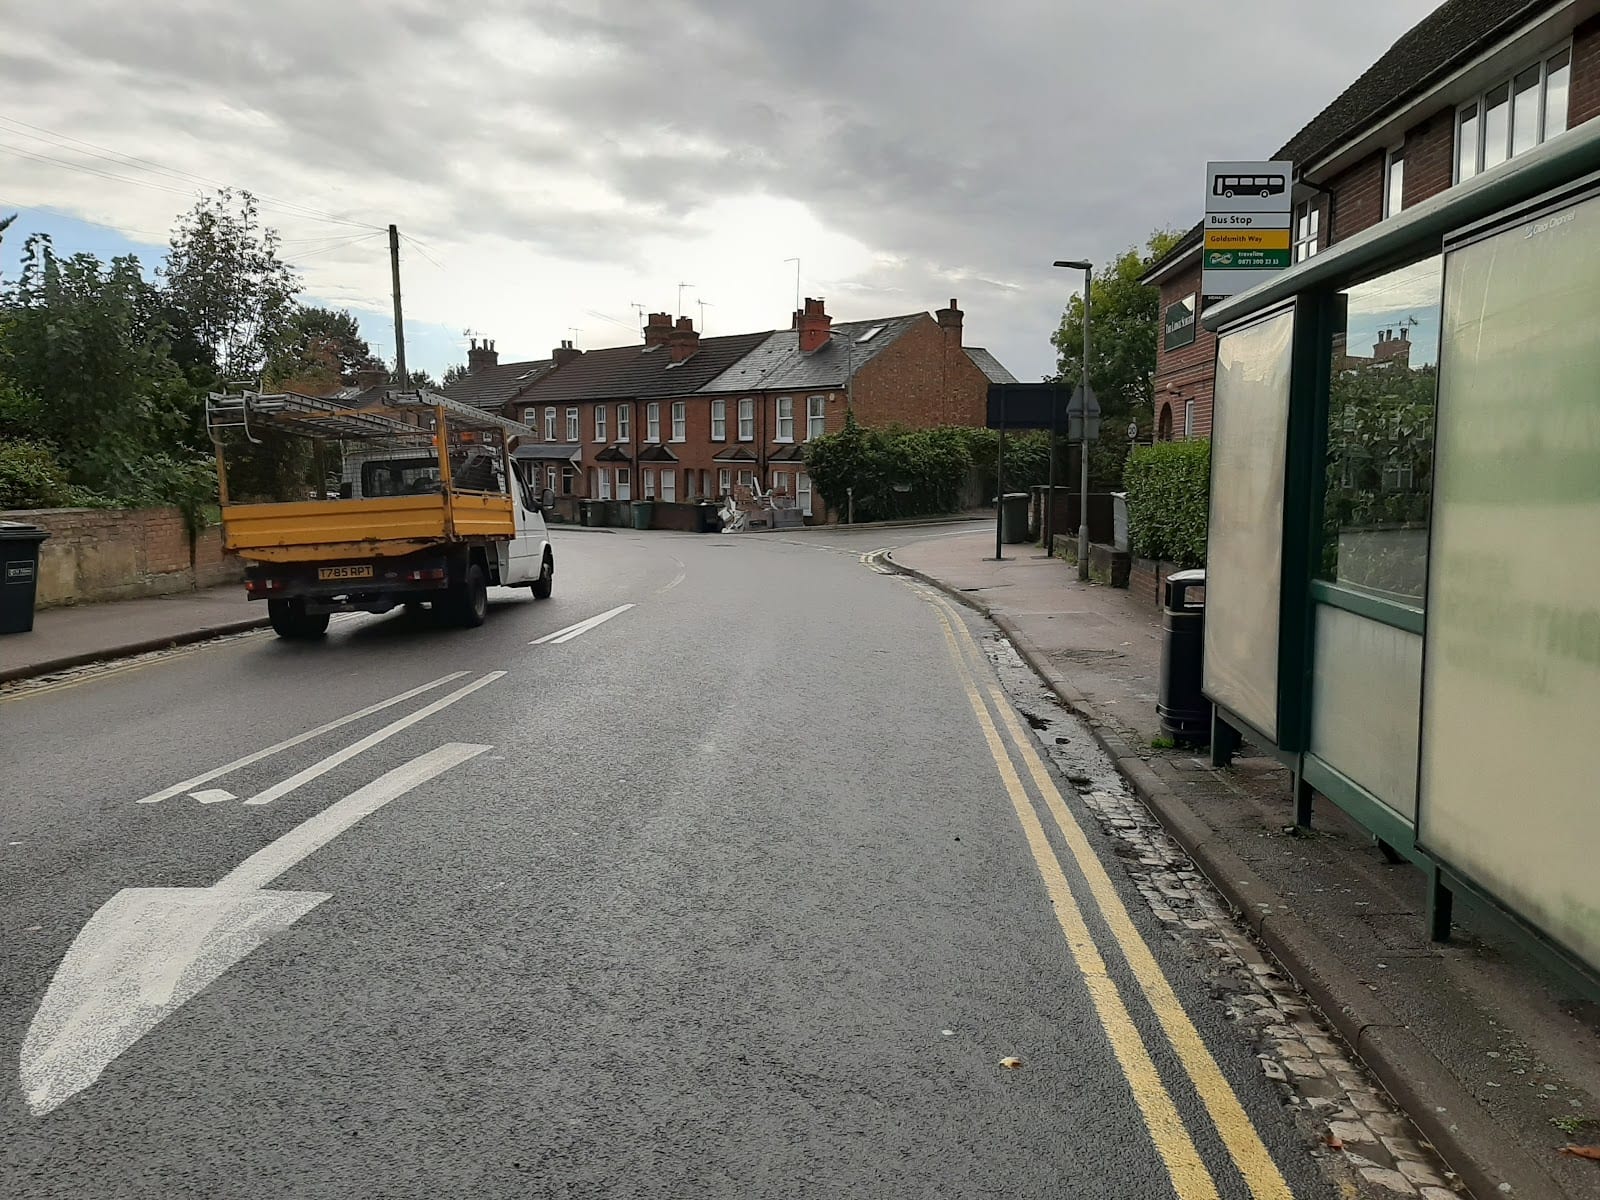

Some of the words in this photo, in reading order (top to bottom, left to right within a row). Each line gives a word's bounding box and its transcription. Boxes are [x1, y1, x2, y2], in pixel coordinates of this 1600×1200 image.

[1211, 216, 1228, 224] Bus
[1230, 216, 1252, 226] Stop
[1248, 235, 1262, 243] Way
[320, 567, 348, 578] T785
[350, 566, 371, 576] RPT
